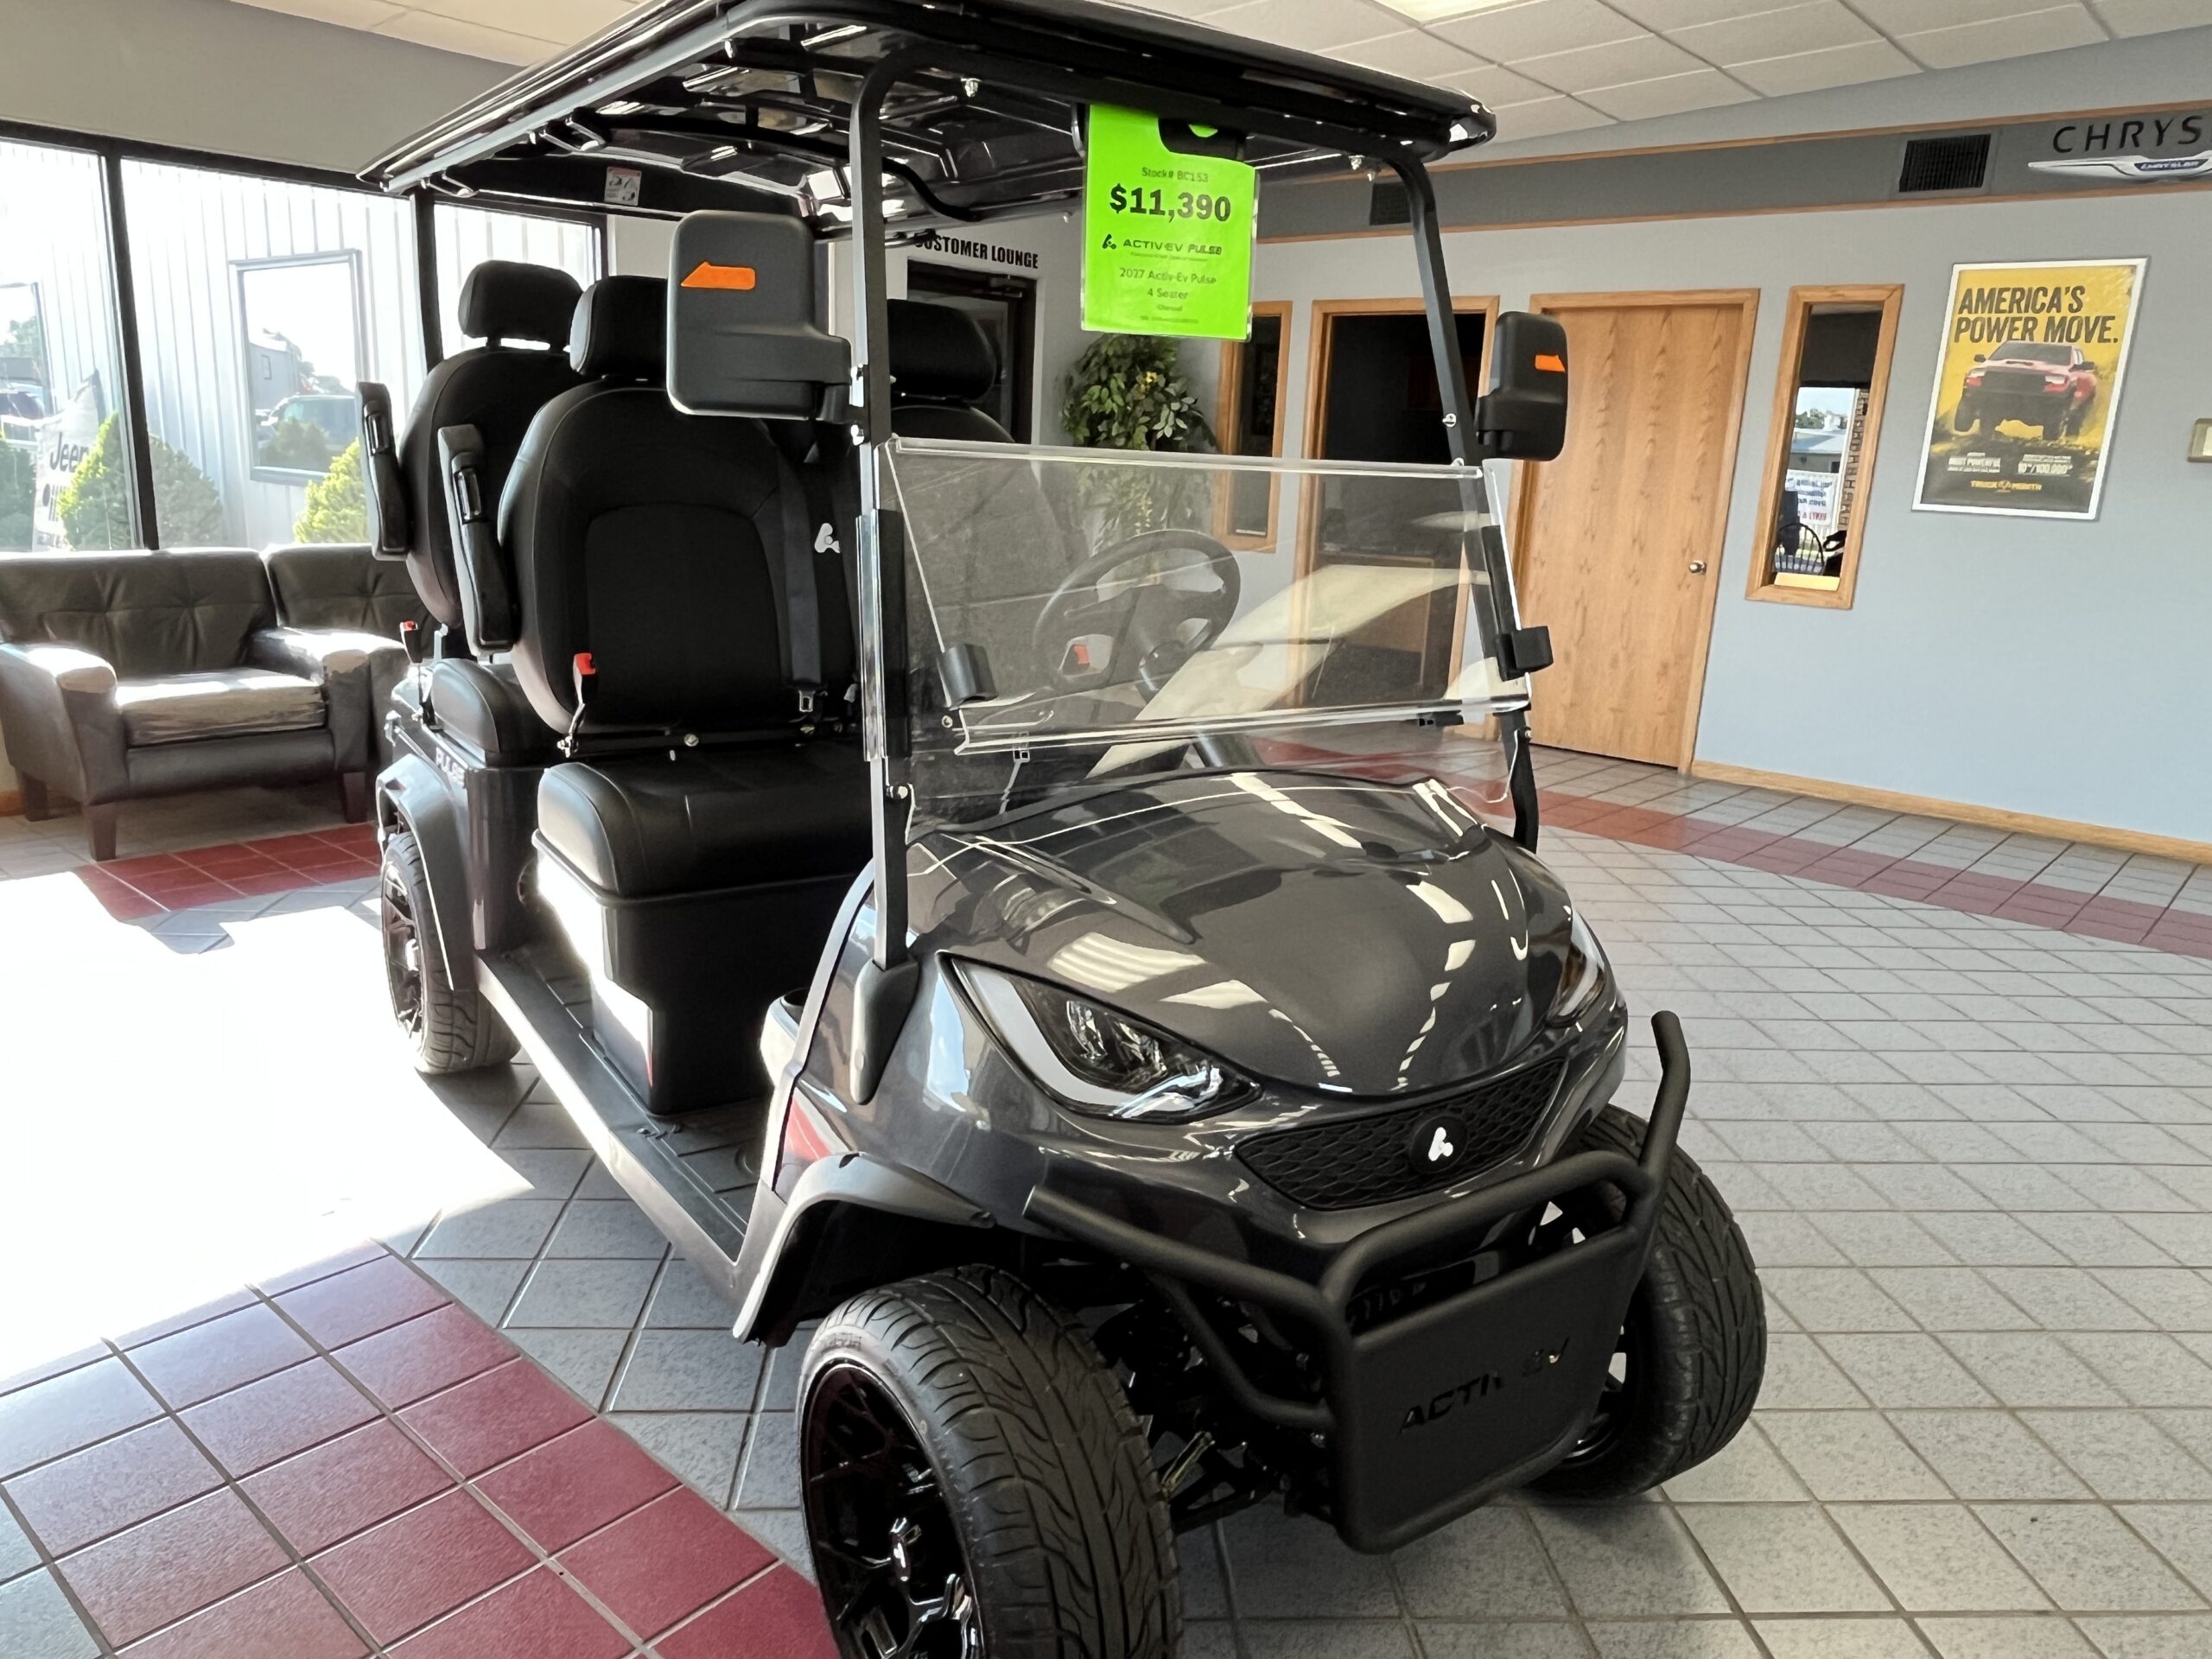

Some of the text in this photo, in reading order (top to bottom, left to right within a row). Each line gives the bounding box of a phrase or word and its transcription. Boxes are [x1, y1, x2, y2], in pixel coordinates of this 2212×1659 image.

[1141, 167, 1173, 178] Stock#
[1109, 183, 1231, 223] $11,390
[916, 235, 1039, 269] USTOMER LOUNGE
[1188, 244, 1222, 255] PULSE
[1191, 273, 1217, 284] Pulse
[1147, 289, 1188, 299] 4 Seater
[1958, 285, 2085, 315] AMERICA'S
[1954, 315, 2119, 344] POWER MOVE.
